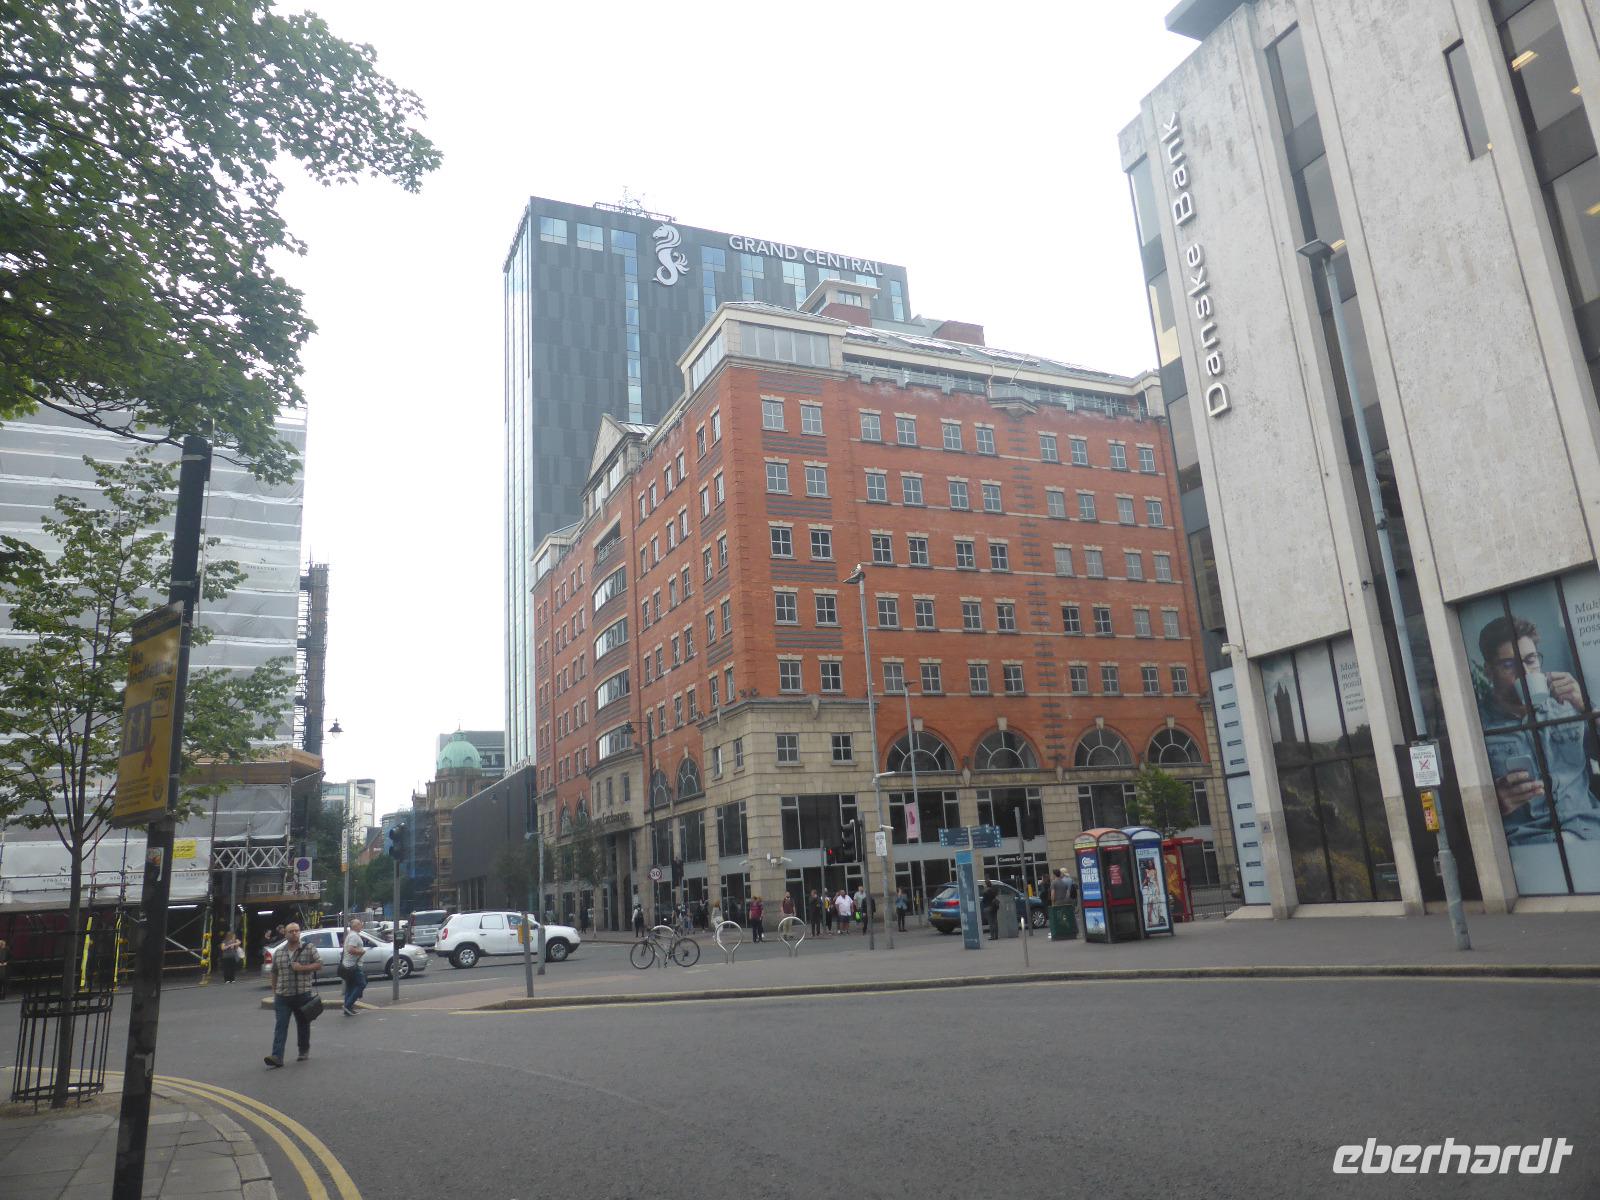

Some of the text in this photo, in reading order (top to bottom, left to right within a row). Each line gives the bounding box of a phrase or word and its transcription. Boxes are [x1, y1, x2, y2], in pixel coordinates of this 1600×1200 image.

[728, 235, 884, 276] GRAND CENTRAL
[1160, 112, 1232, 417] Danske Bank
